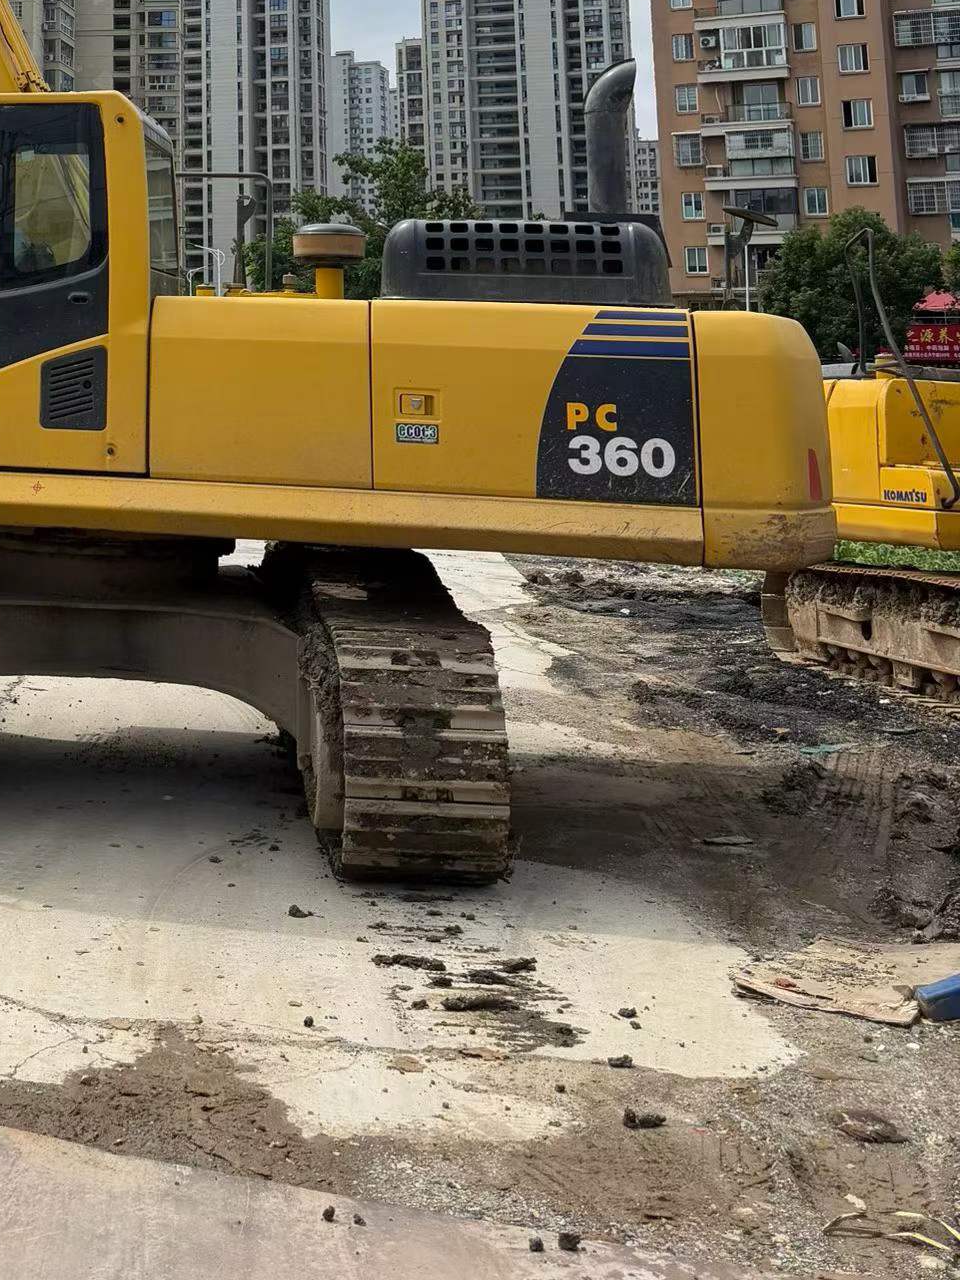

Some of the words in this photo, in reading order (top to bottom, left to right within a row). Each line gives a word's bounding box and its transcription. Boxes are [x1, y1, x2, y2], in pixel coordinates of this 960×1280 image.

[566, 402, 618, 432] PC
[567, 435, 676, 478] 360
[883, 488, 928, 503] KOMATSU
